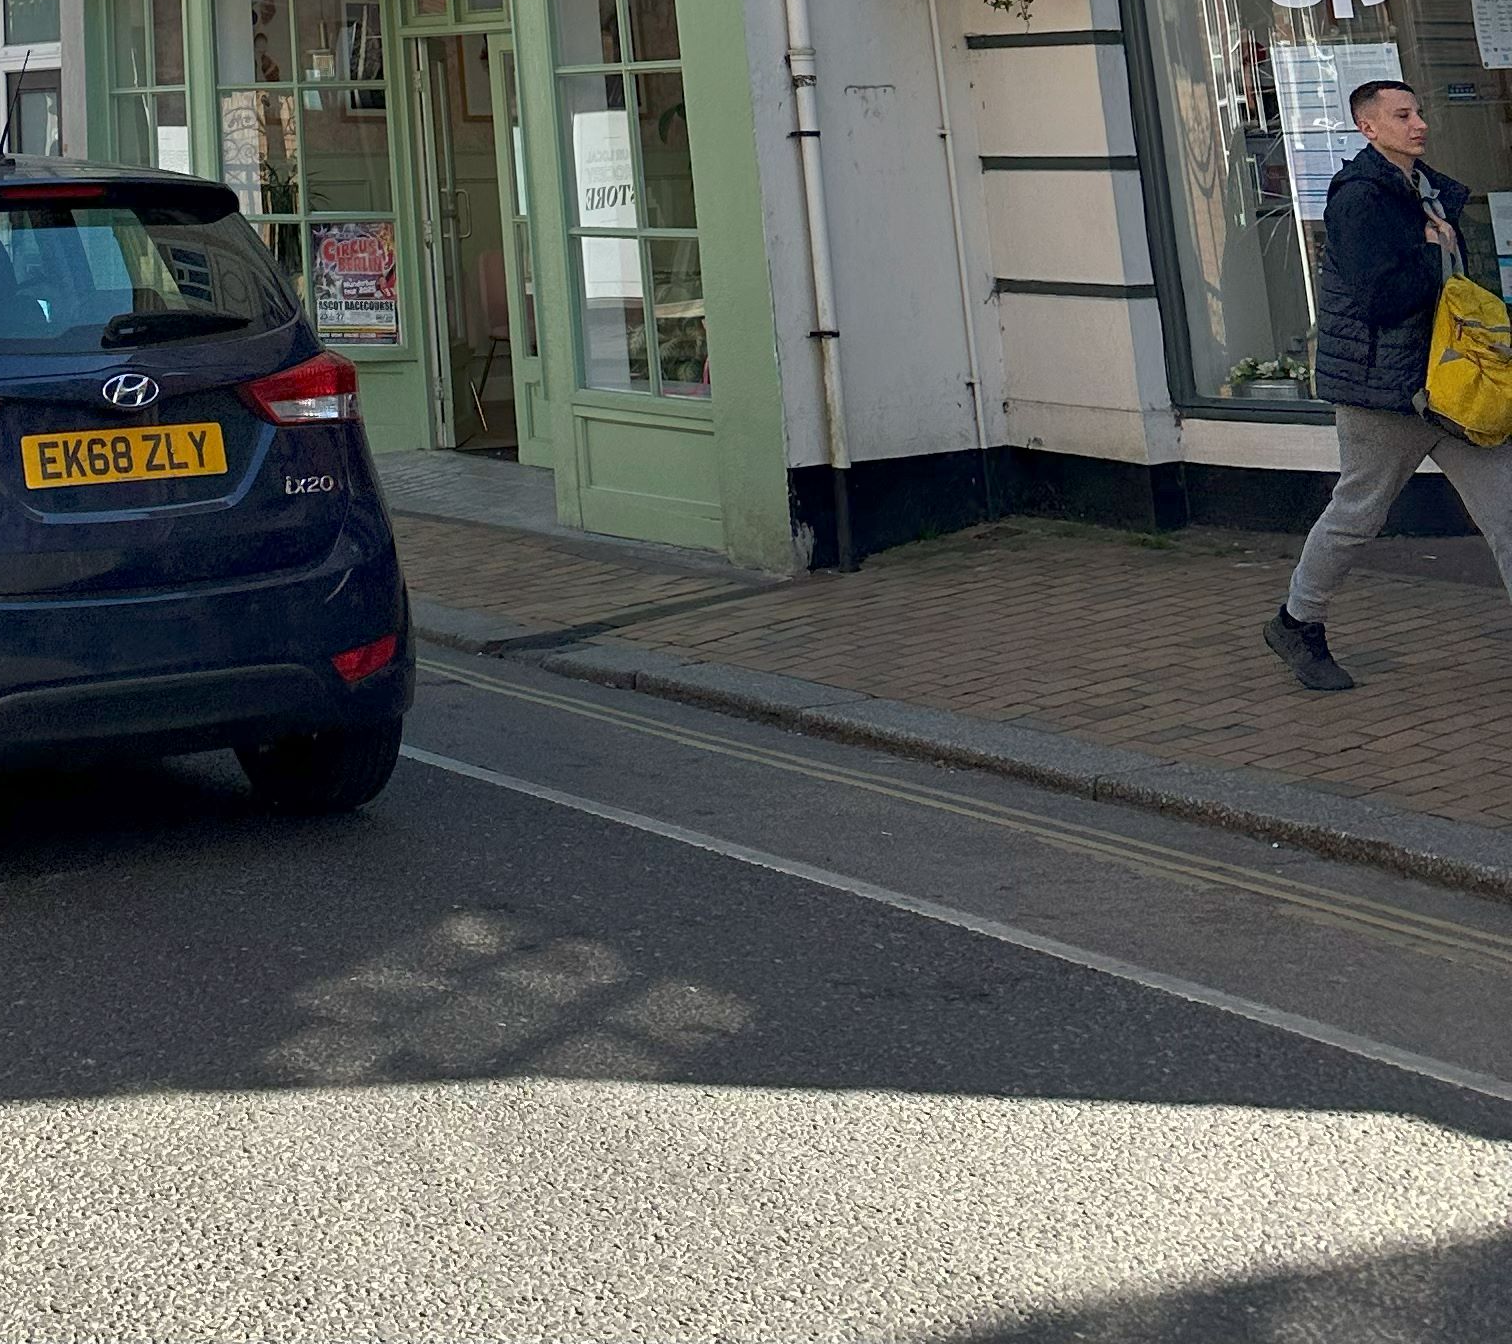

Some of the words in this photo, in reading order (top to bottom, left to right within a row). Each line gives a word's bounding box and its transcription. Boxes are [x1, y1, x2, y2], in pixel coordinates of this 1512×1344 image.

[338, 255, 384, 272] BERLIN
[319, 301, 344, 311] ASCOT
[345, 301, 394, 311] RACECOURSE
[37, 435, 133, 480] EK68
[141, 430, 208, 471] ZLY
[285, 475, 335, 494] ix20
